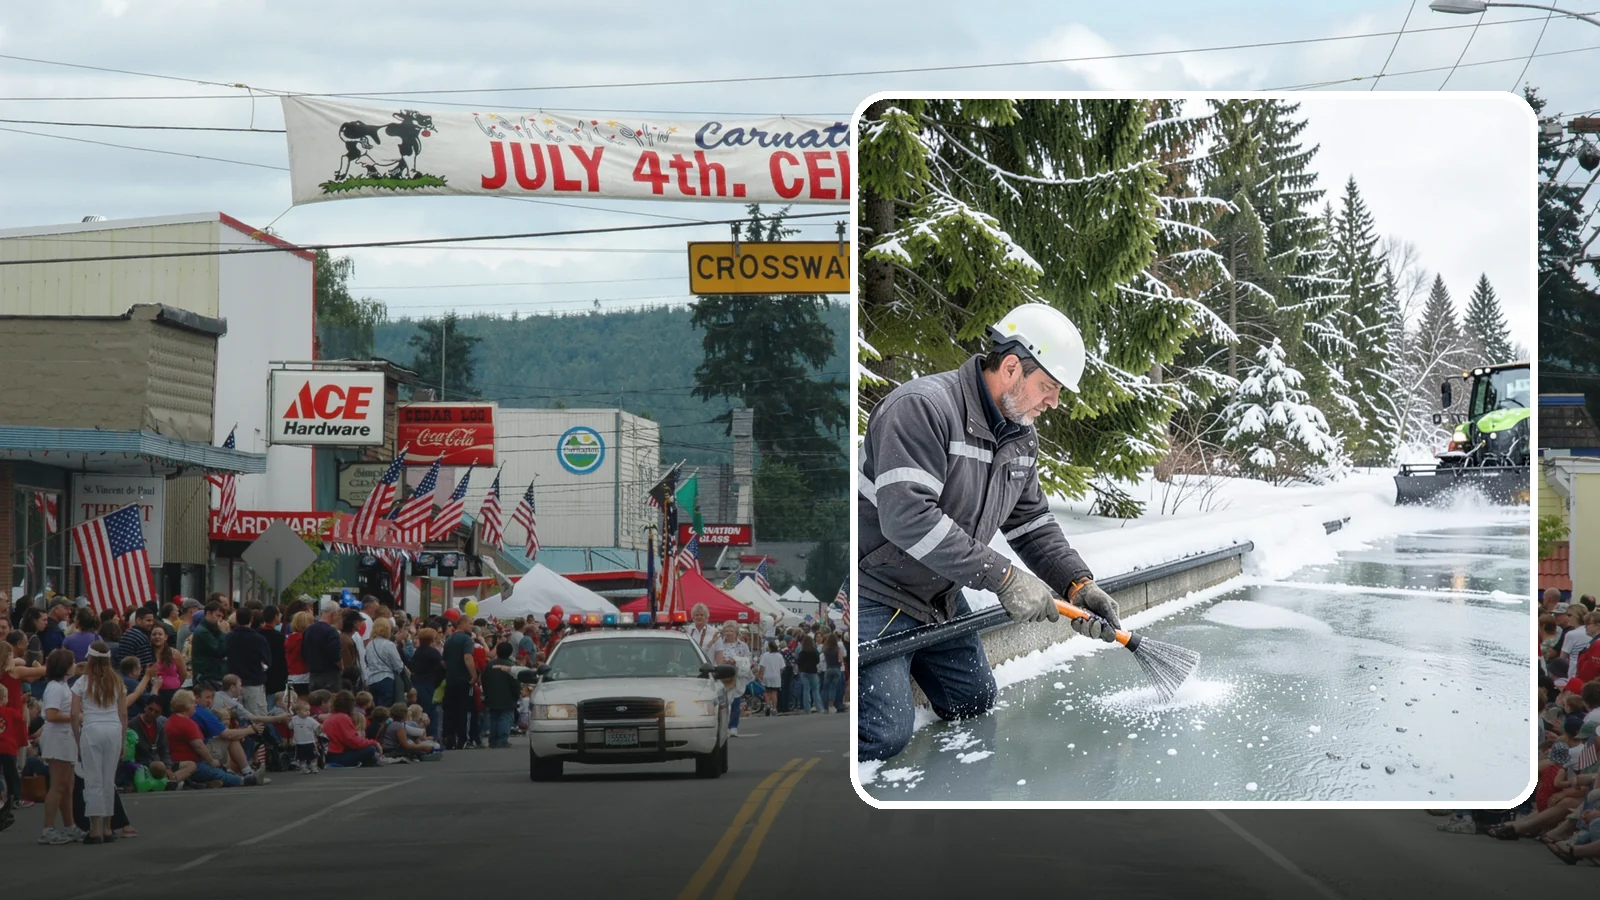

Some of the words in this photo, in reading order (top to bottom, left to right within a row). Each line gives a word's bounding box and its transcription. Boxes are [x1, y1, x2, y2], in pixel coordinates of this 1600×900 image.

[481, 141, 605, 192] JULY
[632, 150, 746, 198] 4th.
[697, 254, 850, 280] CROSSWA
[283, 380, 373, 420] ACE
[405, 409, 453, 423] CEDAR
[461, 409, 485, 422] LOG
[283, 421, 371, 436] Hardware
[353, 466, 385, 480] Simpl
[83, 485, 94, 494] St.
[95, 485, 124, 495] Vincent
[126, 486, 135, 495] de
[137, 486, 155, 495] Paul
[688, 526, 741, 535] CRNATION
[699, 535, 730, 543] GLASS
